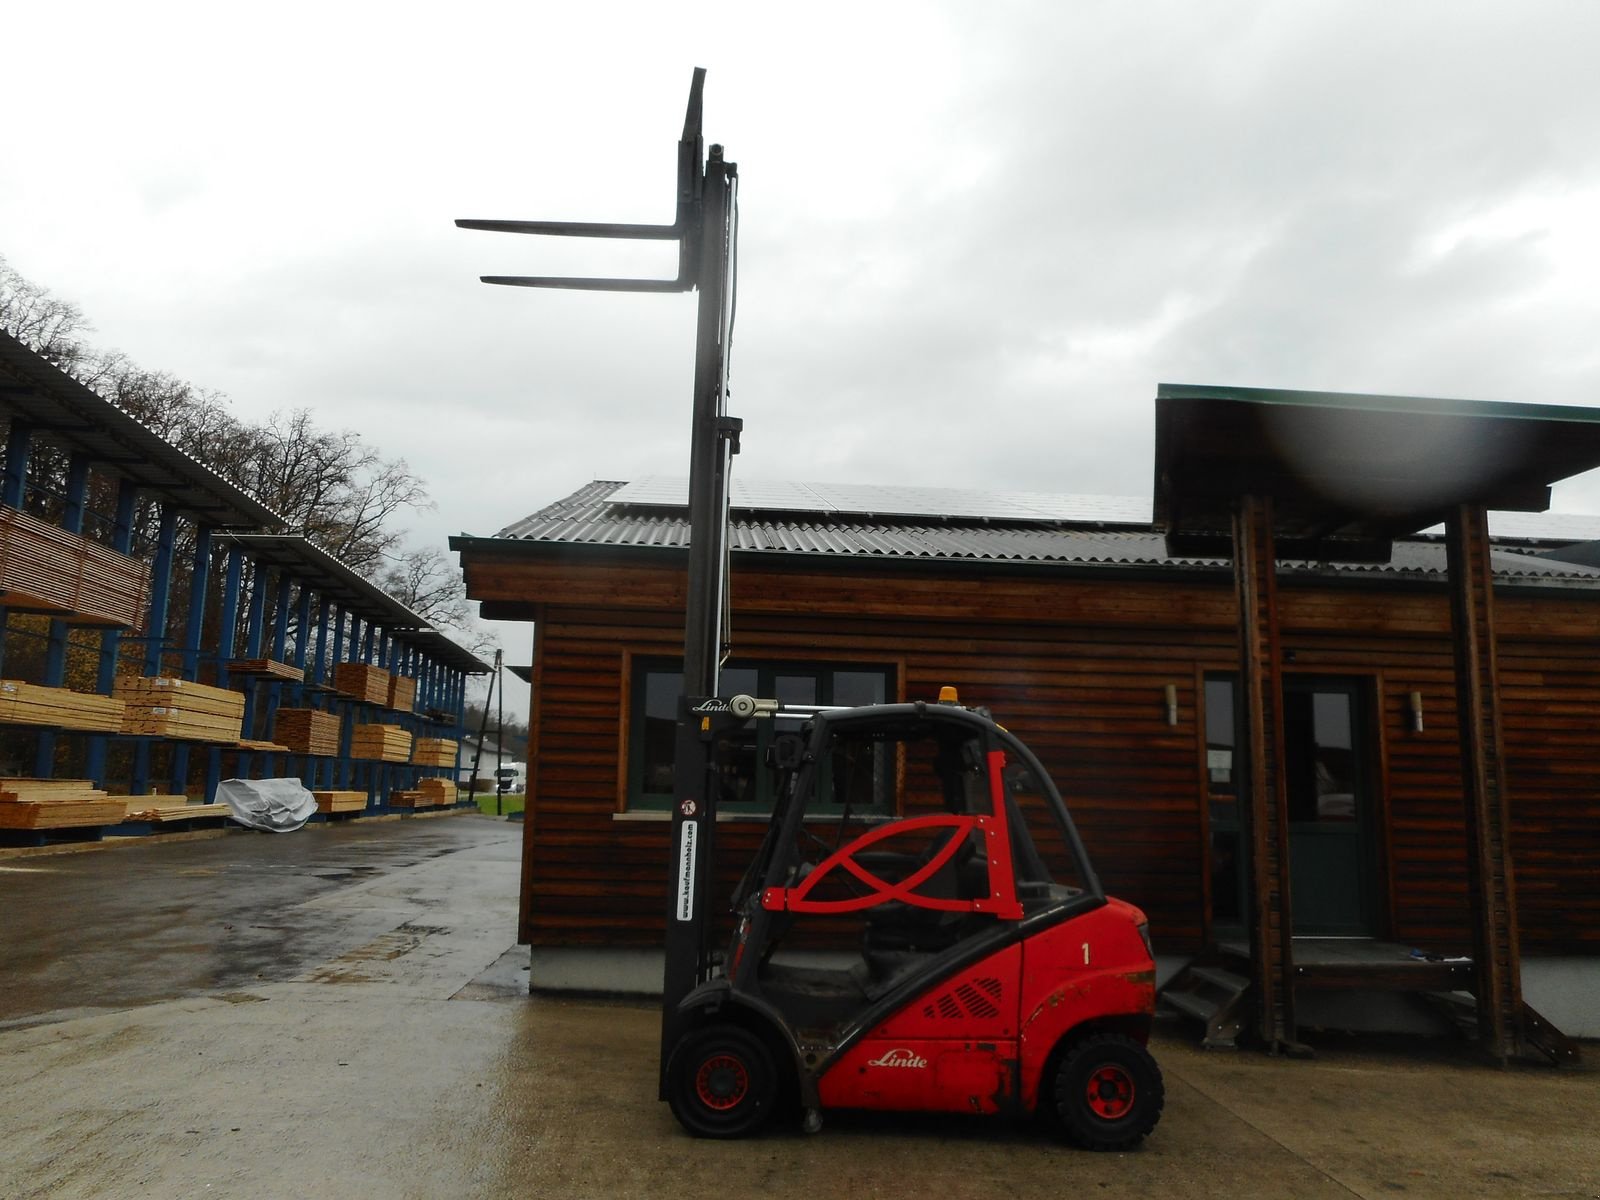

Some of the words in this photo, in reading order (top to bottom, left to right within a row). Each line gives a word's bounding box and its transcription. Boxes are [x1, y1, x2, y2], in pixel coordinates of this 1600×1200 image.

[682, 823, 693, 919] www.kaufmannholz.com
[1081, 943, 1090, 965] 1
[867, 1048, 928, 1068] Linde
